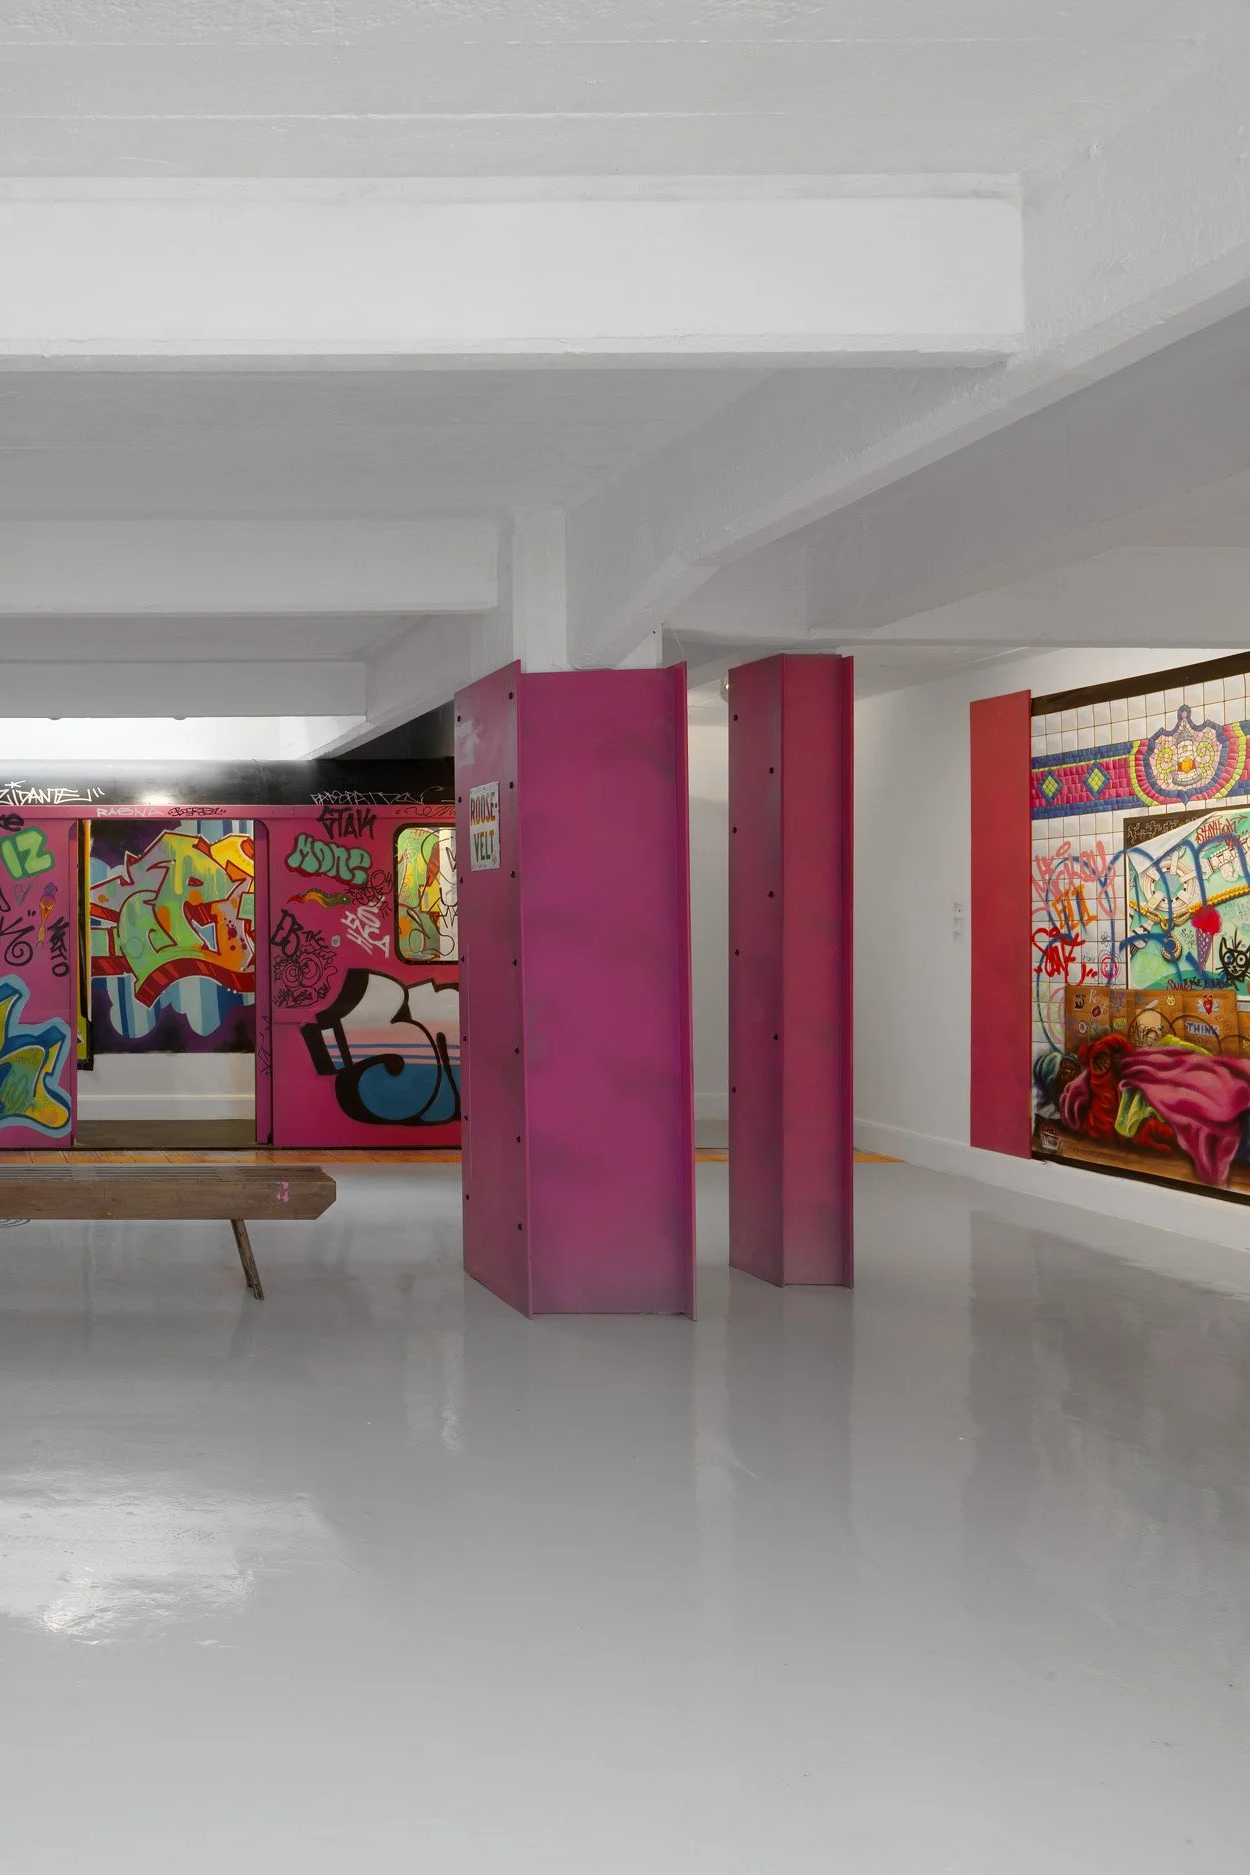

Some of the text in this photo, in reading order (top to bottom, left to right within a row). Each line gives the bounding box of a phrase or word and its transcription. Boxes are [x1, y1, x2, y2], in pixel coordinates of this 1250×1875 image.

[470, 791, 498, 827] ROOSE-
[473, 829, 495, 862] VELT
[1185, 1021, 1221, 1036] THINK
